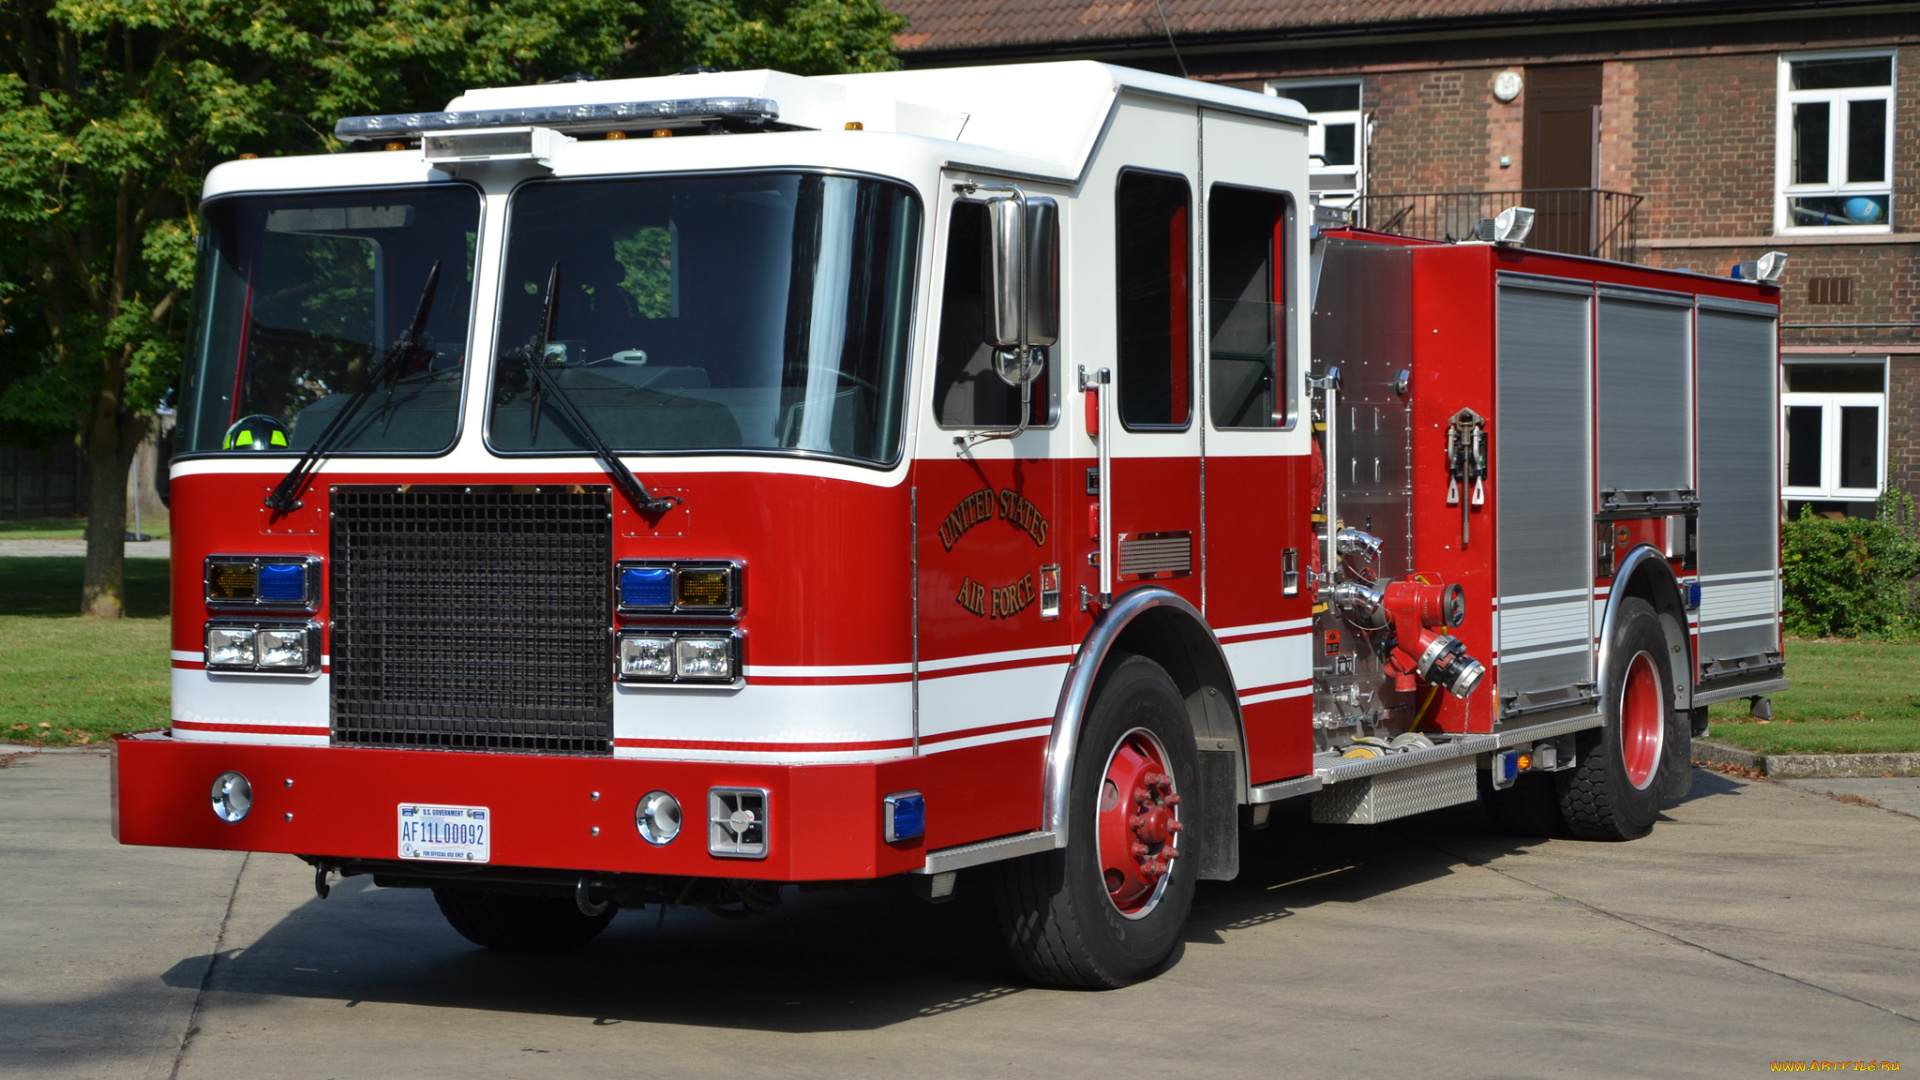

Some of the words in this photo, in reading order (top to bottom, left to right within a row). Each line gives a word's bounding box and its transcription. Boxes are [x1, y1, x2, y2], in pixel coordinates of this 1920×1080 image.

[938, 488, 995, 553] UNITED
[999, 487, 1050, 547] STATES
[955, 575, 986, 618] AIR
[990, 571, 1036, 620] FORCE
[423, 808, 431, 816] U.S.
[432, 809, 464, 817] GOVERNMENT
[402, 821, 484, 845] AF11L00092
